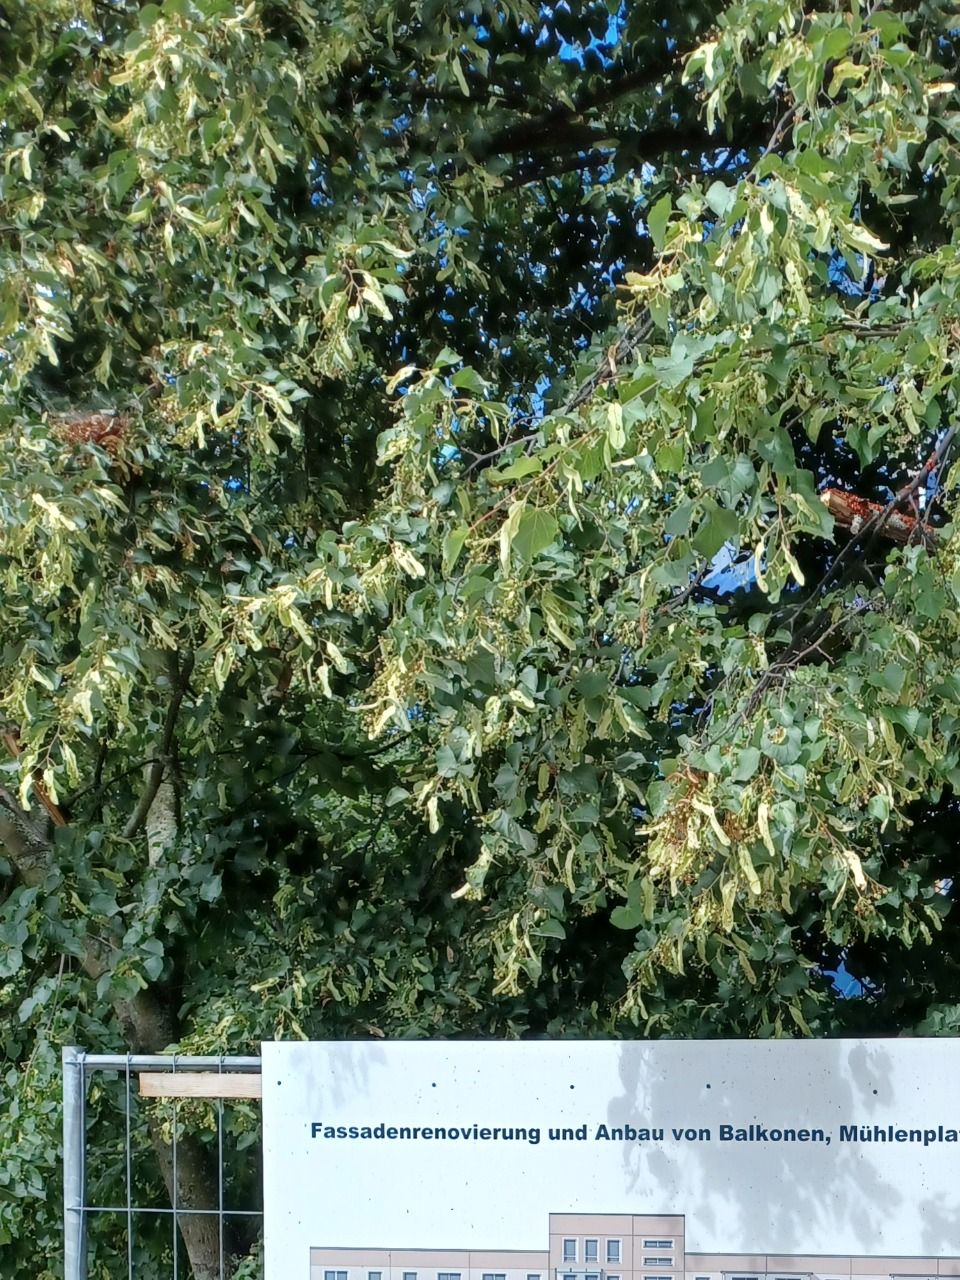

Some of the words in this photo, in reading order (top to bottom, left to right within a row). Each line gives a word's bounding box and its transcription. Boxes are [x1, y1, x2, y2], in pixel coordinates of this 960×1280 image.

[310, 1122, 540, 1145] Fassadenrenovierung
[548, 1123, 588, 1143] und
[595, 1123, 665, 1143] Anbau
[671, 1127, 711, 1143] von
[718, 1125, 832, 1147] Balkonen,
